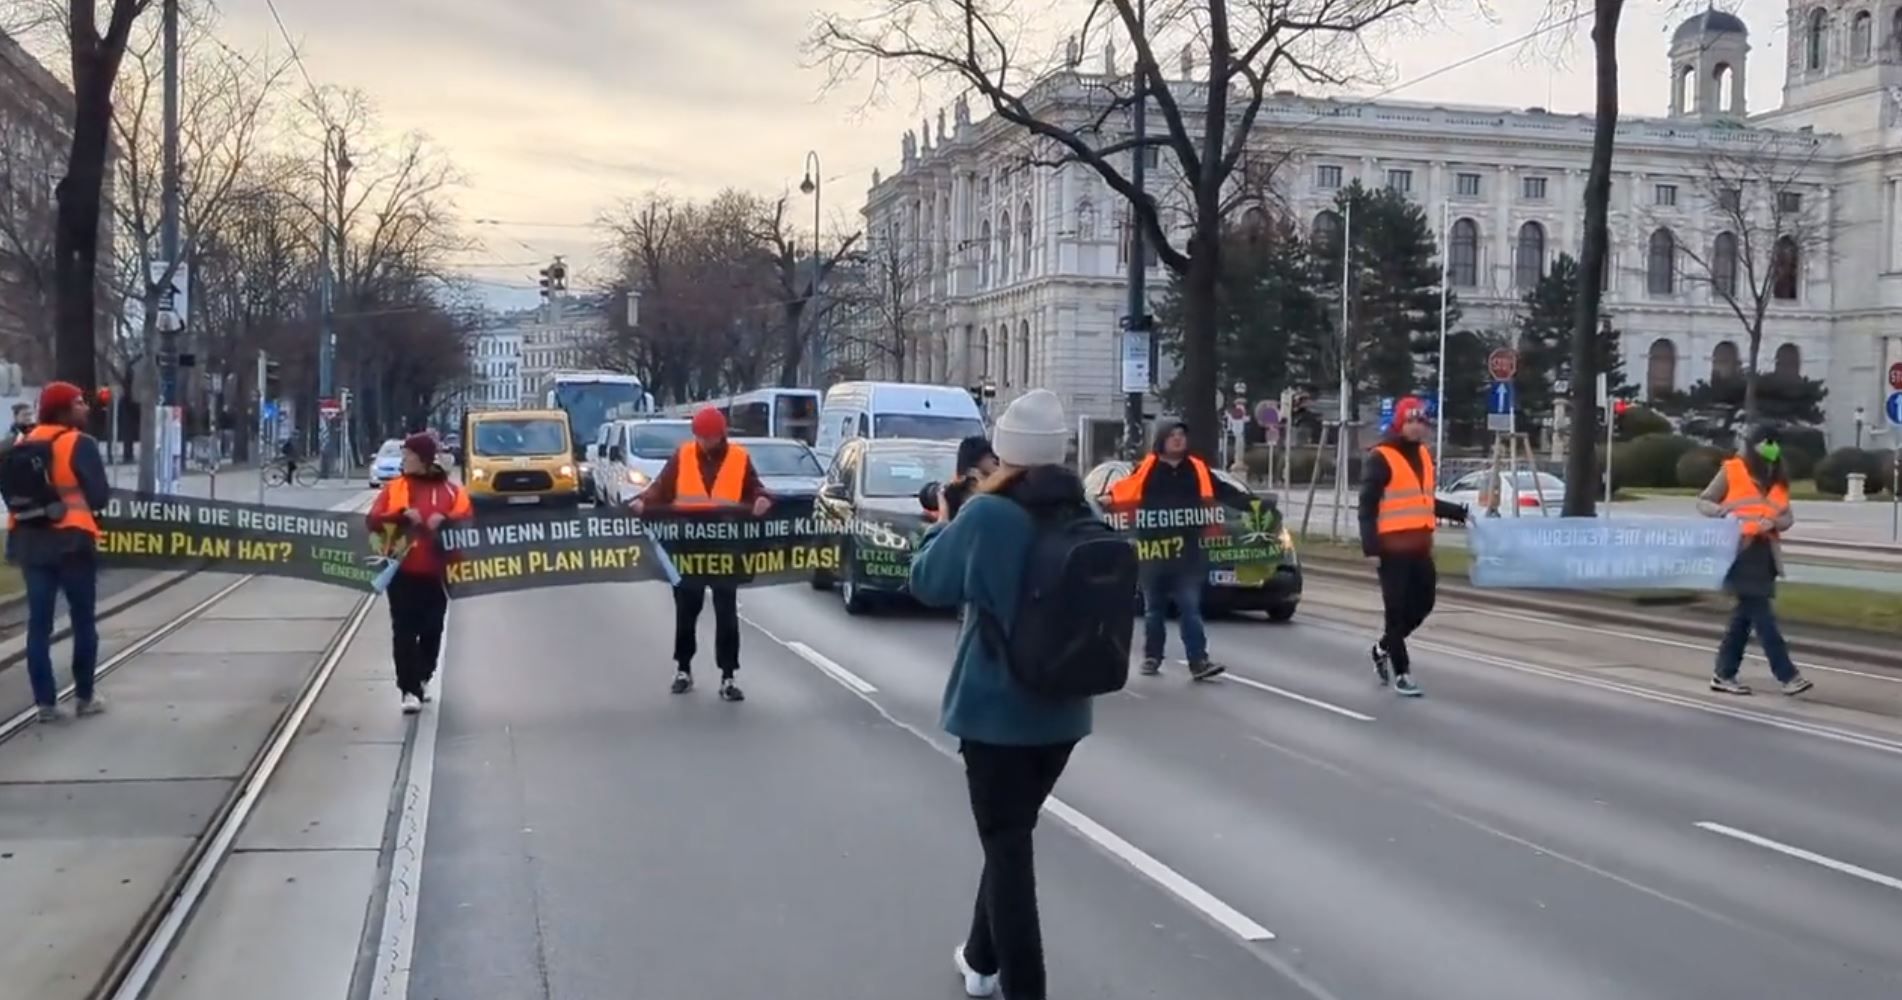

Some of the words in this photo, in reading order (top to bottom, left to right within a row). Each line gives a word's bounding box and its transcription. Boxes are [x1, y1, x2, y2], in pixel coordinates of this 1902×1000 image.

[129, 500, 191, 523] WENN
[199, 506, 230, 526] DIE
[237, 509, 349, 539] REGIERUNG
[684, 518, 739, 541] RASEN
[743, 520, 761, 539] IN
[764, 518, 789, 538] DIE
[1103, 511, 1129, 531] DIE
[1135, 506, 1226, 528] REGIERUNG
[95, 530, 163, 554] EINEN
[170, 531, 231, 557] PLAN
[237, 539, 293, 562] HAT?
[441, 527, 480, 551] UND
[486, 521, 545, 545] WENN
[551, 519, 582, 541] DIE
[588, 516, 643, 538] REGIE
[311, 546, 355, 563] LETZTE
[741, 548, 785, 574] VOM
[791, 544, 840, 569] GAS!
[855, 547, 897, 563] LETZTE
[1136, 536, 1184, 561] HAT?
[322, 561, 375, 582] GENERAT
[446, 554, 523, 584] KEINEN
[528, 550, 584, 575] PLAN
[590, 545, 641, 571] HAT?
[865, 562, 910, 578] GENERA
